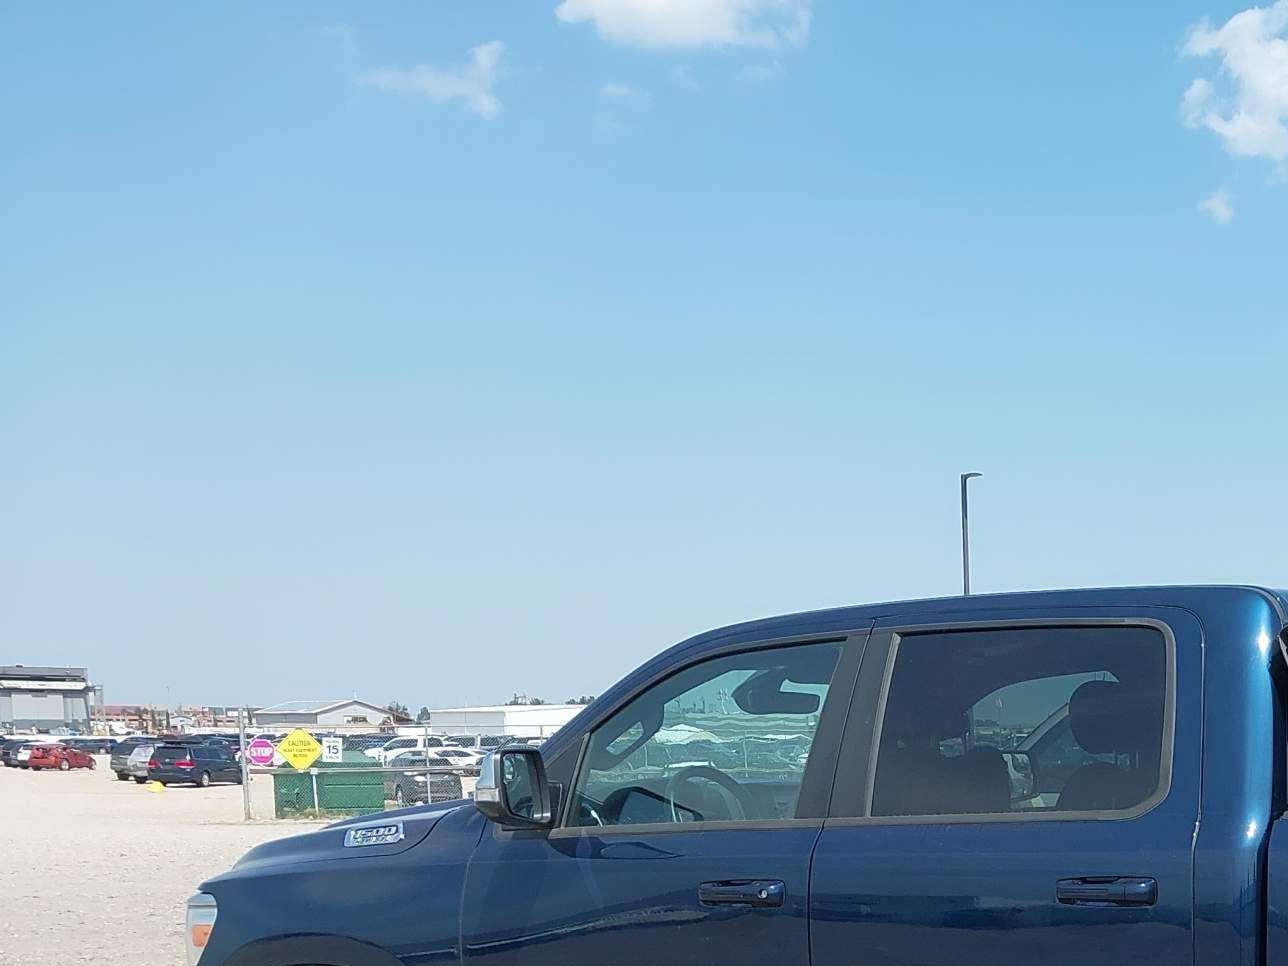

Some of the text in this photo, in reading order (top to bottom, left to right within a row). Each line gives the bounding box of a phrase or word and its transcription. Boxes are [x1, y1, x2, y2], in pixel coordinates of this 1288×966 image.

[250, 747, 273, 756] STOP
[326, 744, 339, 755] 15
[352, 826, 398, 839] 1500
